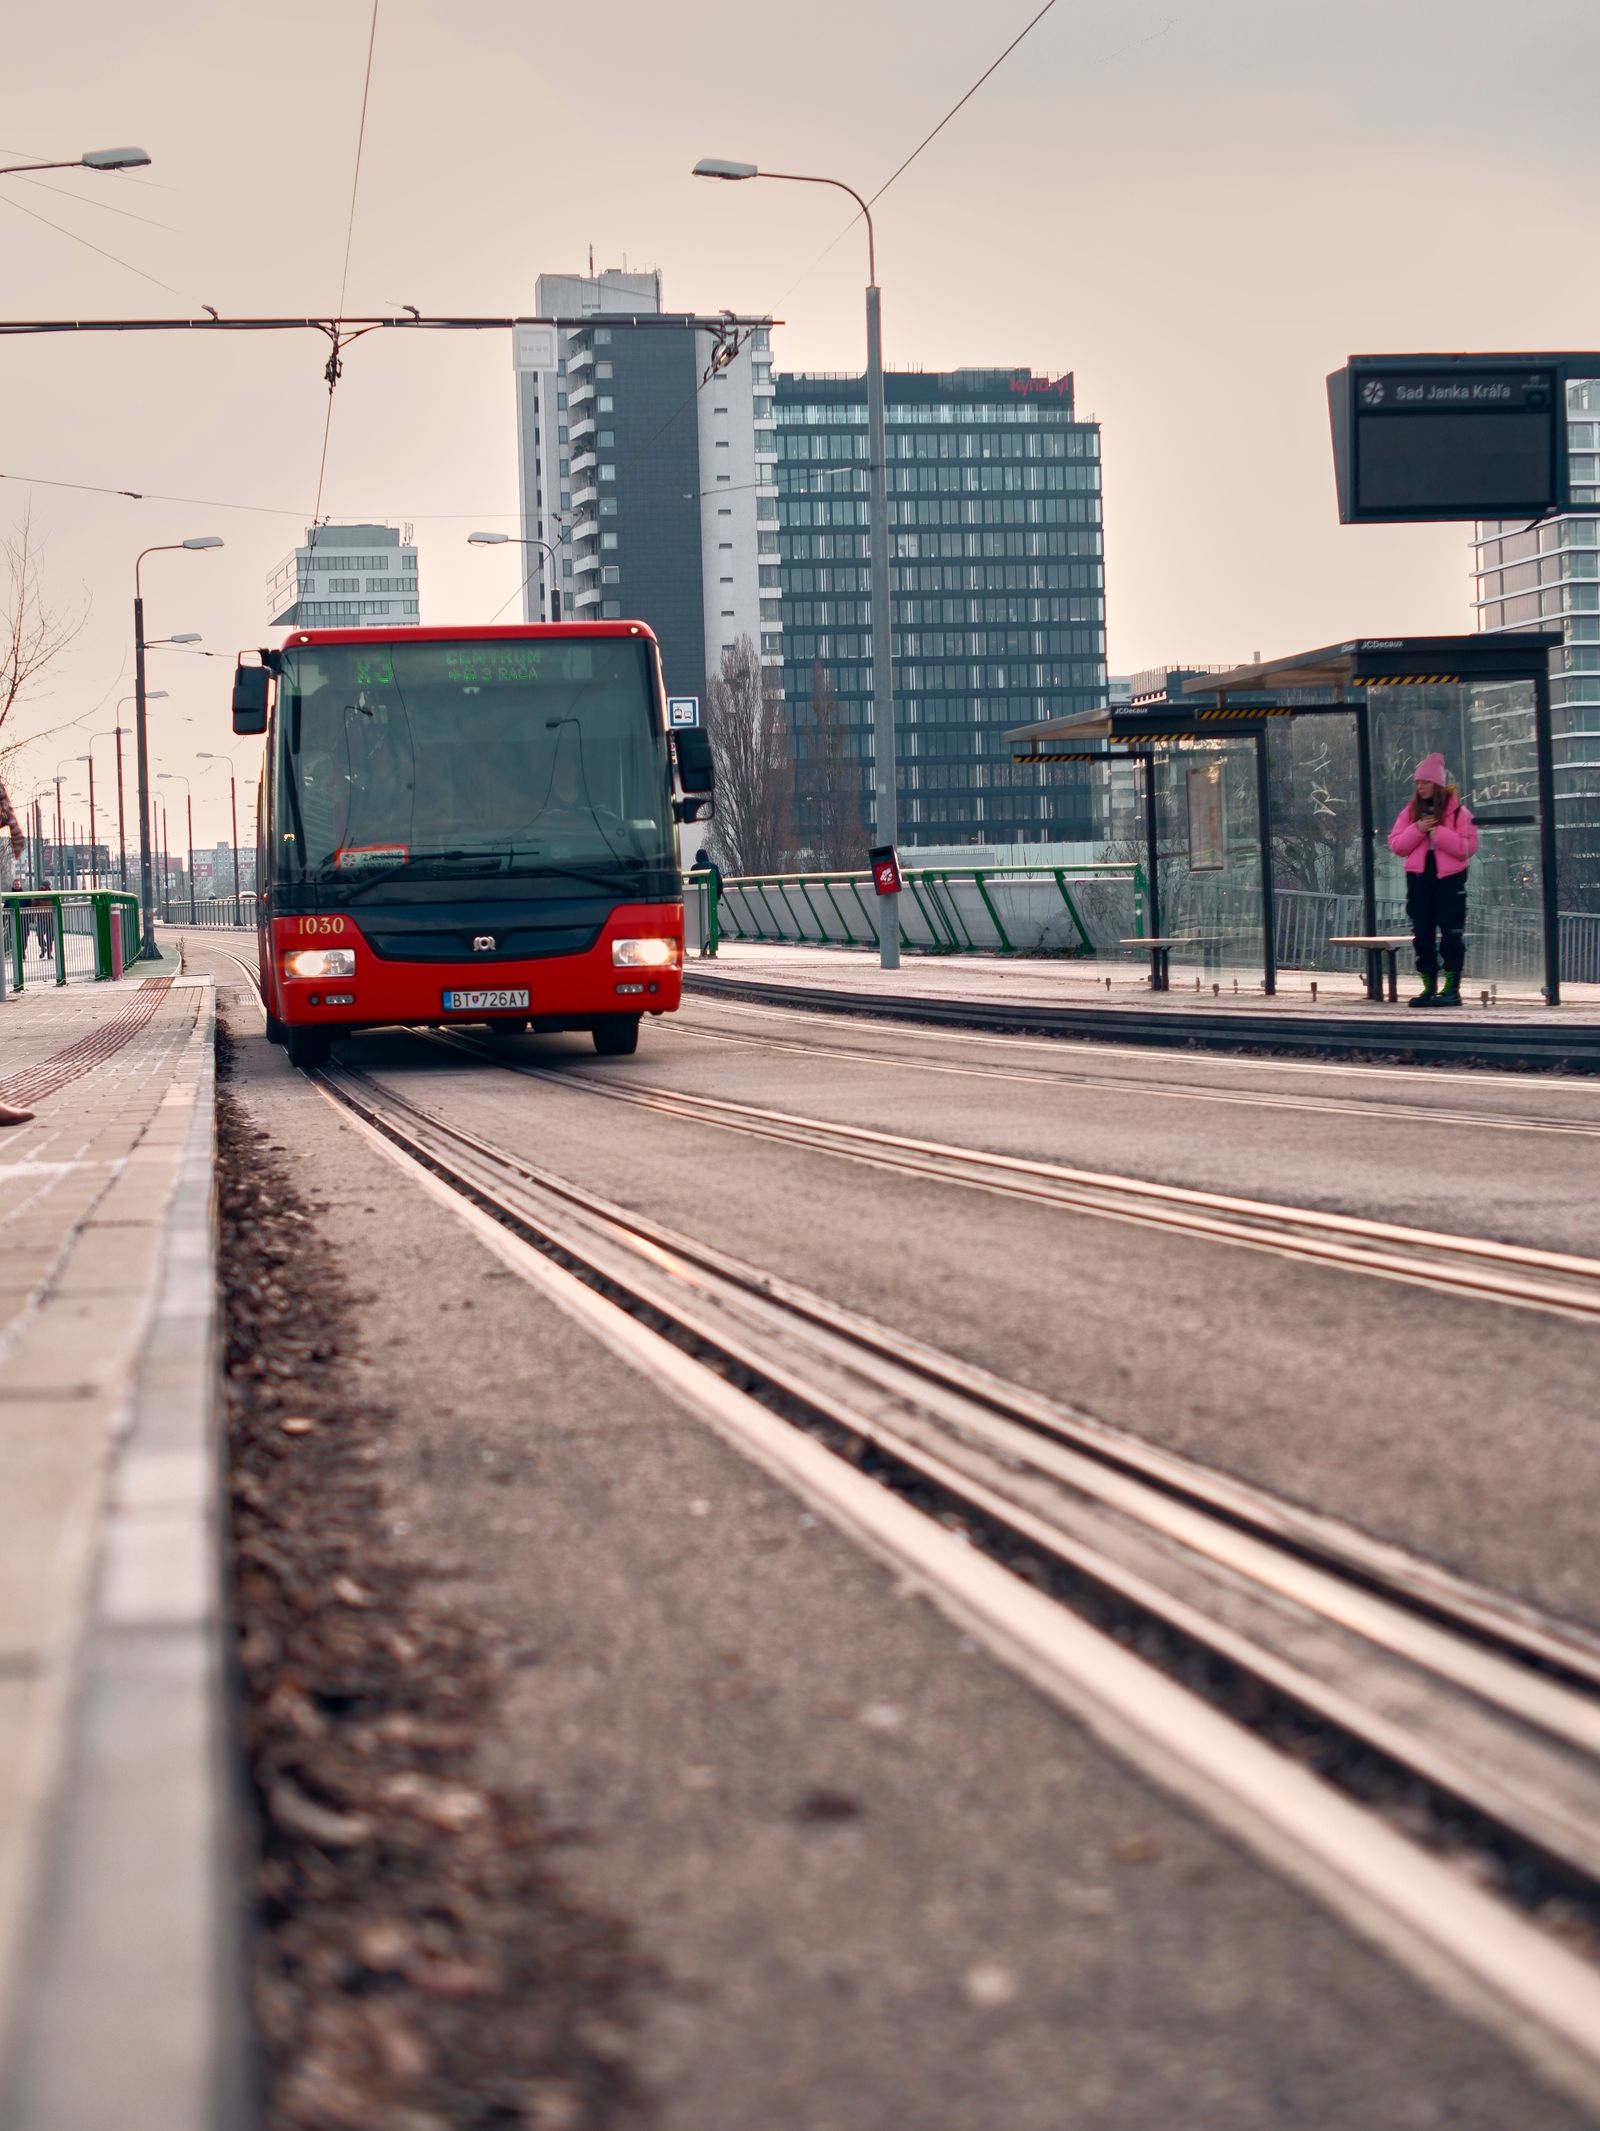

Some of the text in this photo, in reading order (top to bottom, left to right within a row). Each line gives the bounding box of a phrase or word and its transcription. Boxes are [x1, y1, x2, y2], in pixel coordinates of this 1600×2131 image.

[1396, 384, 1424, 400] Sad
[1427, 384, 1469, 400] Janka
[299, 917, 345, 935] 1030
